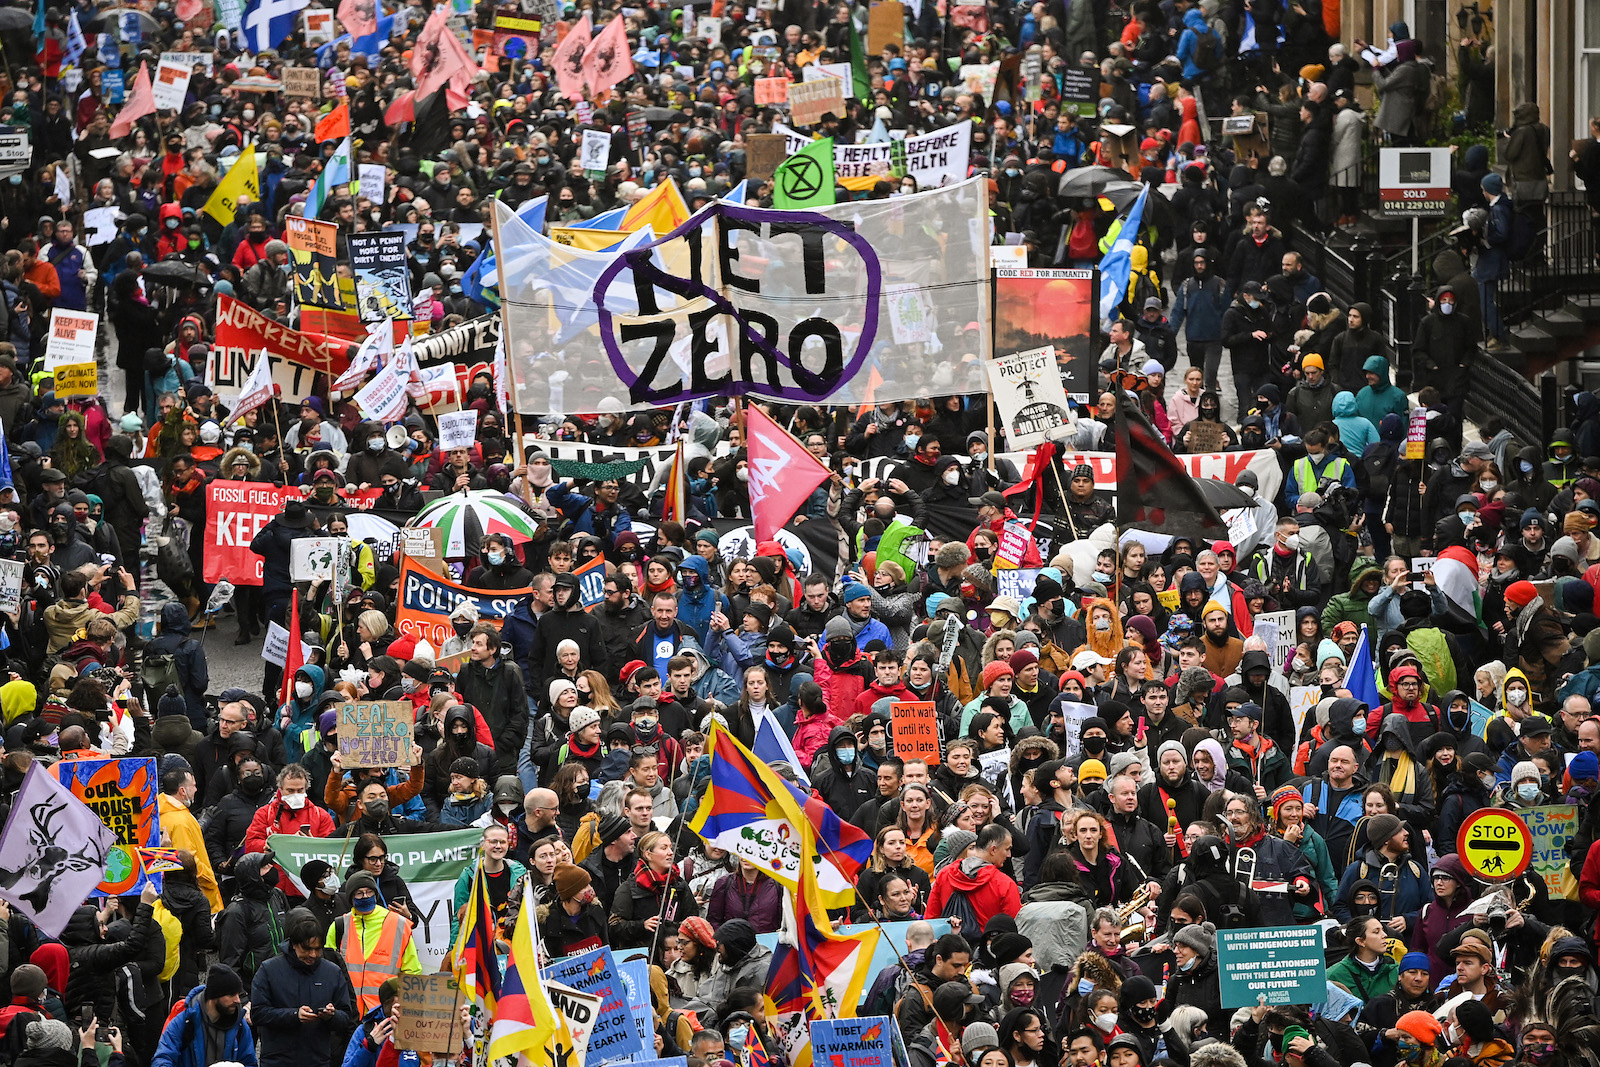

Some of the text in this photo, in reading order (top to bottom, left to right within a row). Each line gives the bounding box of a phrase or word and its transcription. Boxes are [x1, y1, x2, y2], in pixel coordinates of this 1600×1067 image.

[1403, 190, 1427, 198] SOLD
[1384, 201, 1445, 210] 0141 229 0210
[289, 218, 321, 236] NO NEW
[294, 232, 313, 241] FOSSIL
[352, 238, 368, 246] NOT
[380, 236, 404, 245] PENNY
[359, 246, 398, 256] MORE FOR
[354, 254, 405, 264] DIRTY ENERGY
[625, 213, 855, 316] NET
[56, 316, 73, 327] KEEP
[56, 328, 76, 339] ALIVE
[216, 297, 342, 363] WORKERS
[620, 301, 843, 405] ZERO
[68, 368, 94, 377] CLIMATE
[1000, 357, 1047, 377] PROTECT
[1022, 404, 1049, 416] WATER
[1019, 413, 1062, 434] NO LINE 3
[213, 488, 247, 503] FOSSIL
[249, 490, 278, 506] FUELS
[216, 511, 276, 547] KEE
[402, 528, 430, 539] STOP
[1004, 532, 1023, 547] Climate
[1001, 541, 1023, 556] refugees
[998, 550, 1020, 564] welcome
[999, 571, 1019, 579] NO
[1000, 580, 1032, 589] NEW
[1000, 589, 1024, 598] OIL
[1279, 616, 1288, 625] IT
[399, 618, 456, 646] STO
[342, 704, 396, 724] REAL
[894, 706, 934, 718] Don't wait
[898, 723, 930, 735] until it's
[340, 737, 369, 755] NOT
[372, 737, 400, 751] NET
[897, 741, 937, 752] too late.
[360, 751, 397, 764] ZERO
[84, 780, 124, 798] OUR
[102, 815, 132, 826] S ON
[1520, 811, 1545, 824] T'S
[112, 824, 138, 845] RE
[1472, 825, 1516, 838] STOP
[408, 846, 478, 866] PLANET
[1531, 849, 1572, 862] EVER
[1234, 932, 1258, 940] RIGHT
[1259, 929, 1317, 939] RELATIONSHIP
[1250, 940, 1299, 949] INDIGENOUS
[561, 962, 587, 978] TIBET
[1236, 962, 1260, 970] RIGHT
[1261, 959, 1319, 969] RELATIONSHIP
[570, 970, 612, 990] ARMING
[1270, 970, 1296, 978] EARTH
[403, 976, 438, 991] SAVE
[1248, 980, 1300, 990] OUR FUTURE.
[590, 986, 612, 998] MES
[598, 999, 623, 1016] HAN
[592, 1015, 626, 1035] EST OF
[835, 1026, 861, 1036] TIBET
[595, 1031, 628, 1050] EARTH
[817, 1041, 884, 1053] IS WARMING
[830, 1054, 881, 1067] 3 TIMES
